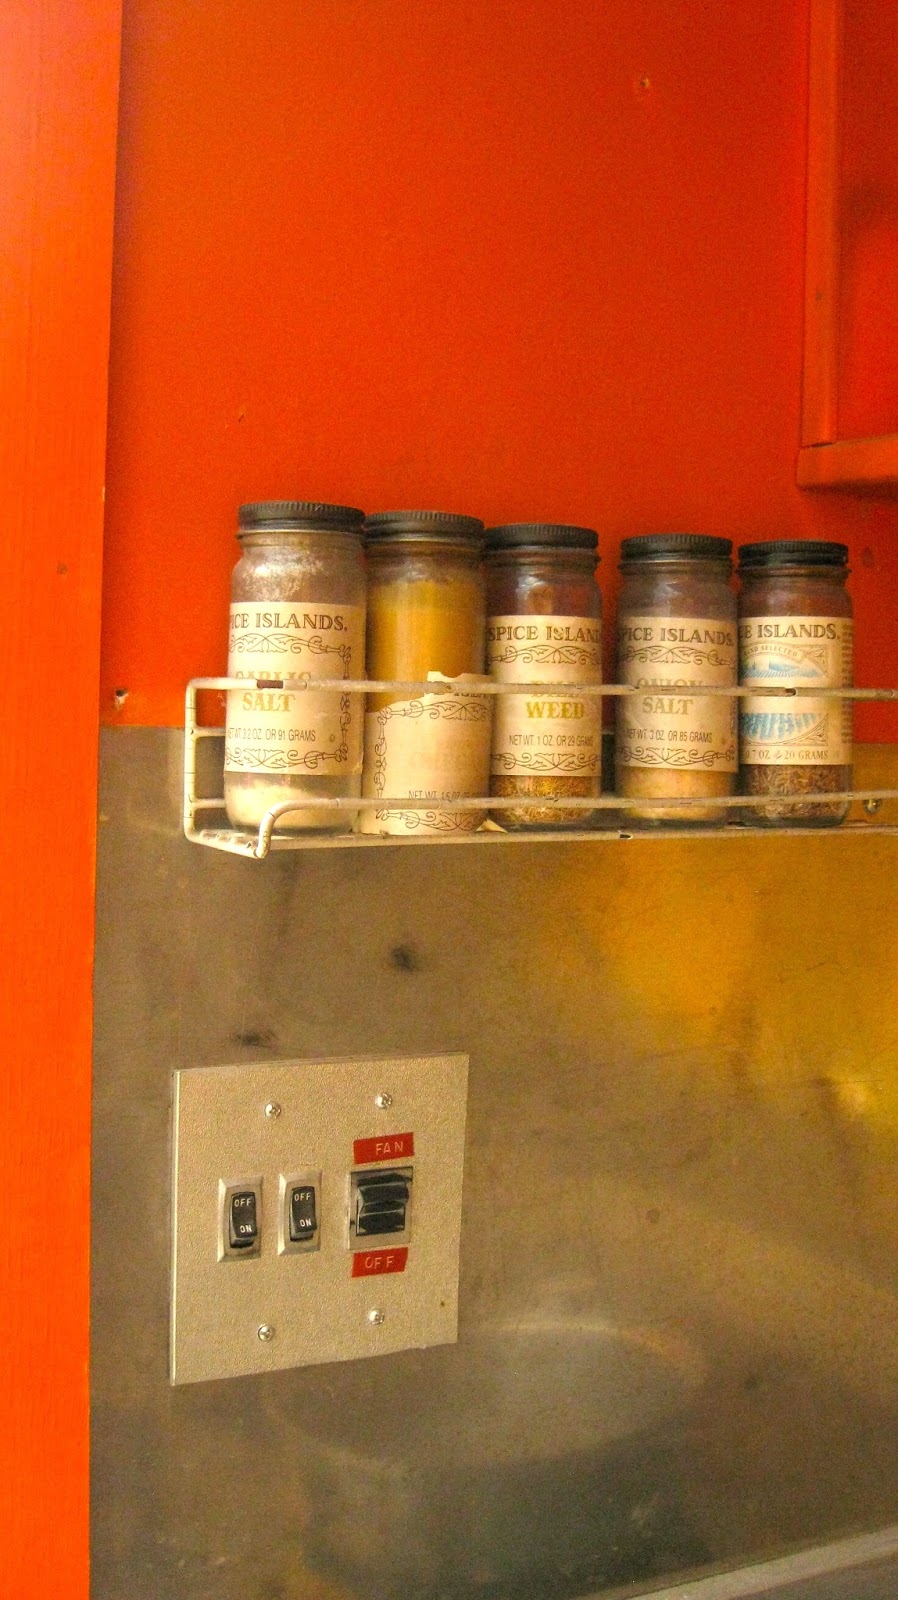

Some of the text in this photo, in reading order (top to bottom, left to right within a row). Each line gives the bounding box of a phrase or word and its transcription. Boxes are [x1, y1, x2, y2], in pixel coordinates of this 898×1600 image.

[488, 625, 538, 642] SPICE
[242, 692, 296, 712] SALT
[642, 697, 693, 715] SALT
[526, 701, 585, 719] WEED
[265, 729, 276, 741] OR
[278, 729, 286, 741] 91
[288, 729, 316, 742] GRAMS
[509, 734, 522, 746] NET
[556, 735, 566, 747] OR
[689, 731, 713, 744] GRAMS
[798, 749, 829, 761] GRAMS
[375, 1140, 404, 1156] FAN
[234, 1197, 252, 1208] OFF
[293, 1191, 311, 1202] OFF
[299, 1217, 312, 1227] ON
[239, 1224, 252, 1234] ON
[364, 1254, 395, 1270] OFF
